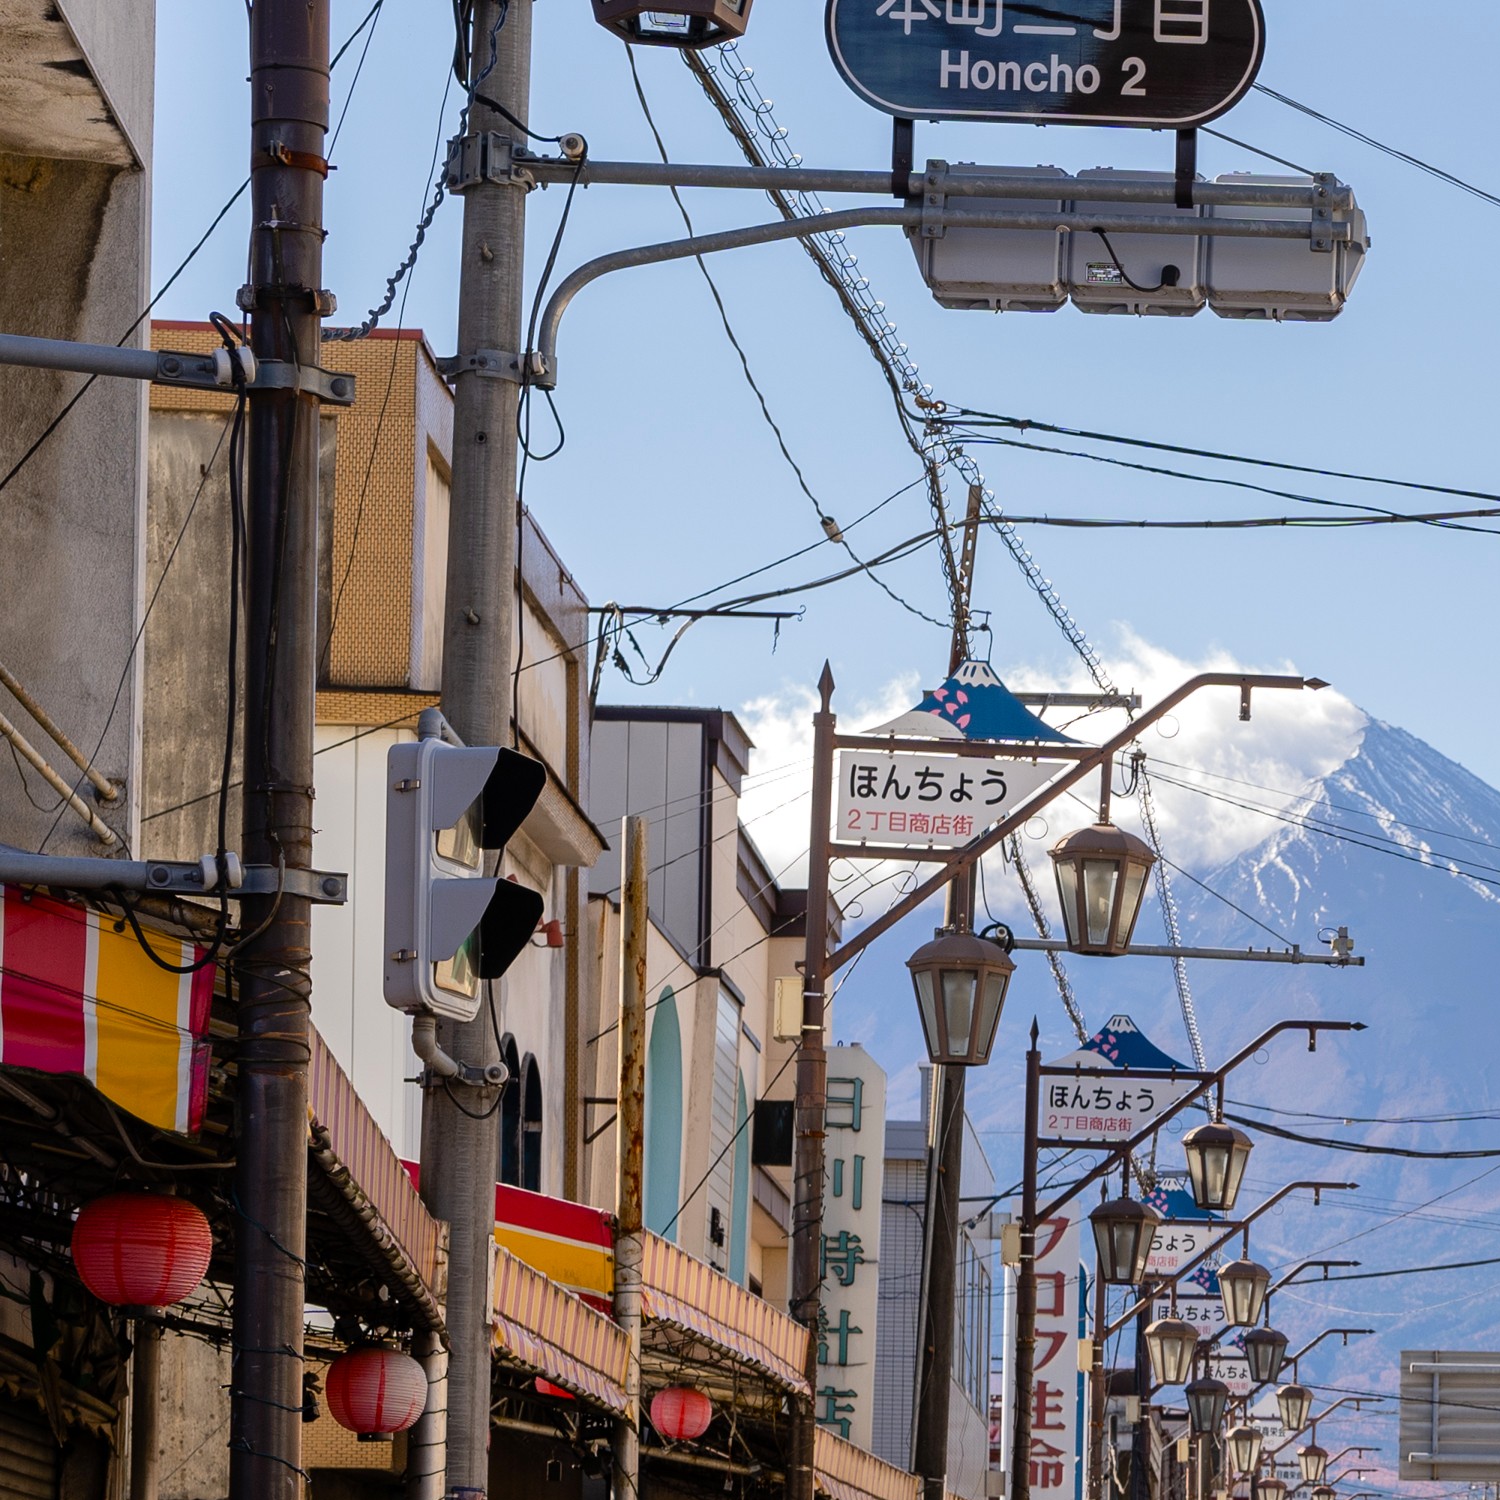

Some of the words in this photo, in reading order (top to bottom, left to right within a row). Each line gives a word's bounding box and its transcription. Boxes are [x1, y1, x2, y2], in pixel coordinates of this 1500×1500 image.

[940, 50, 1101, 94] Honcho
[1120, 57, 1147, 96] 2
[850, 764, 1007, 805] ほんちょう
[847, 808, 974, 837] 2丁目商店街
[1050, 1085, 1154, 1112] ほんちょう
[1049, 1114, 1132, 1132] 2丁目商店街
